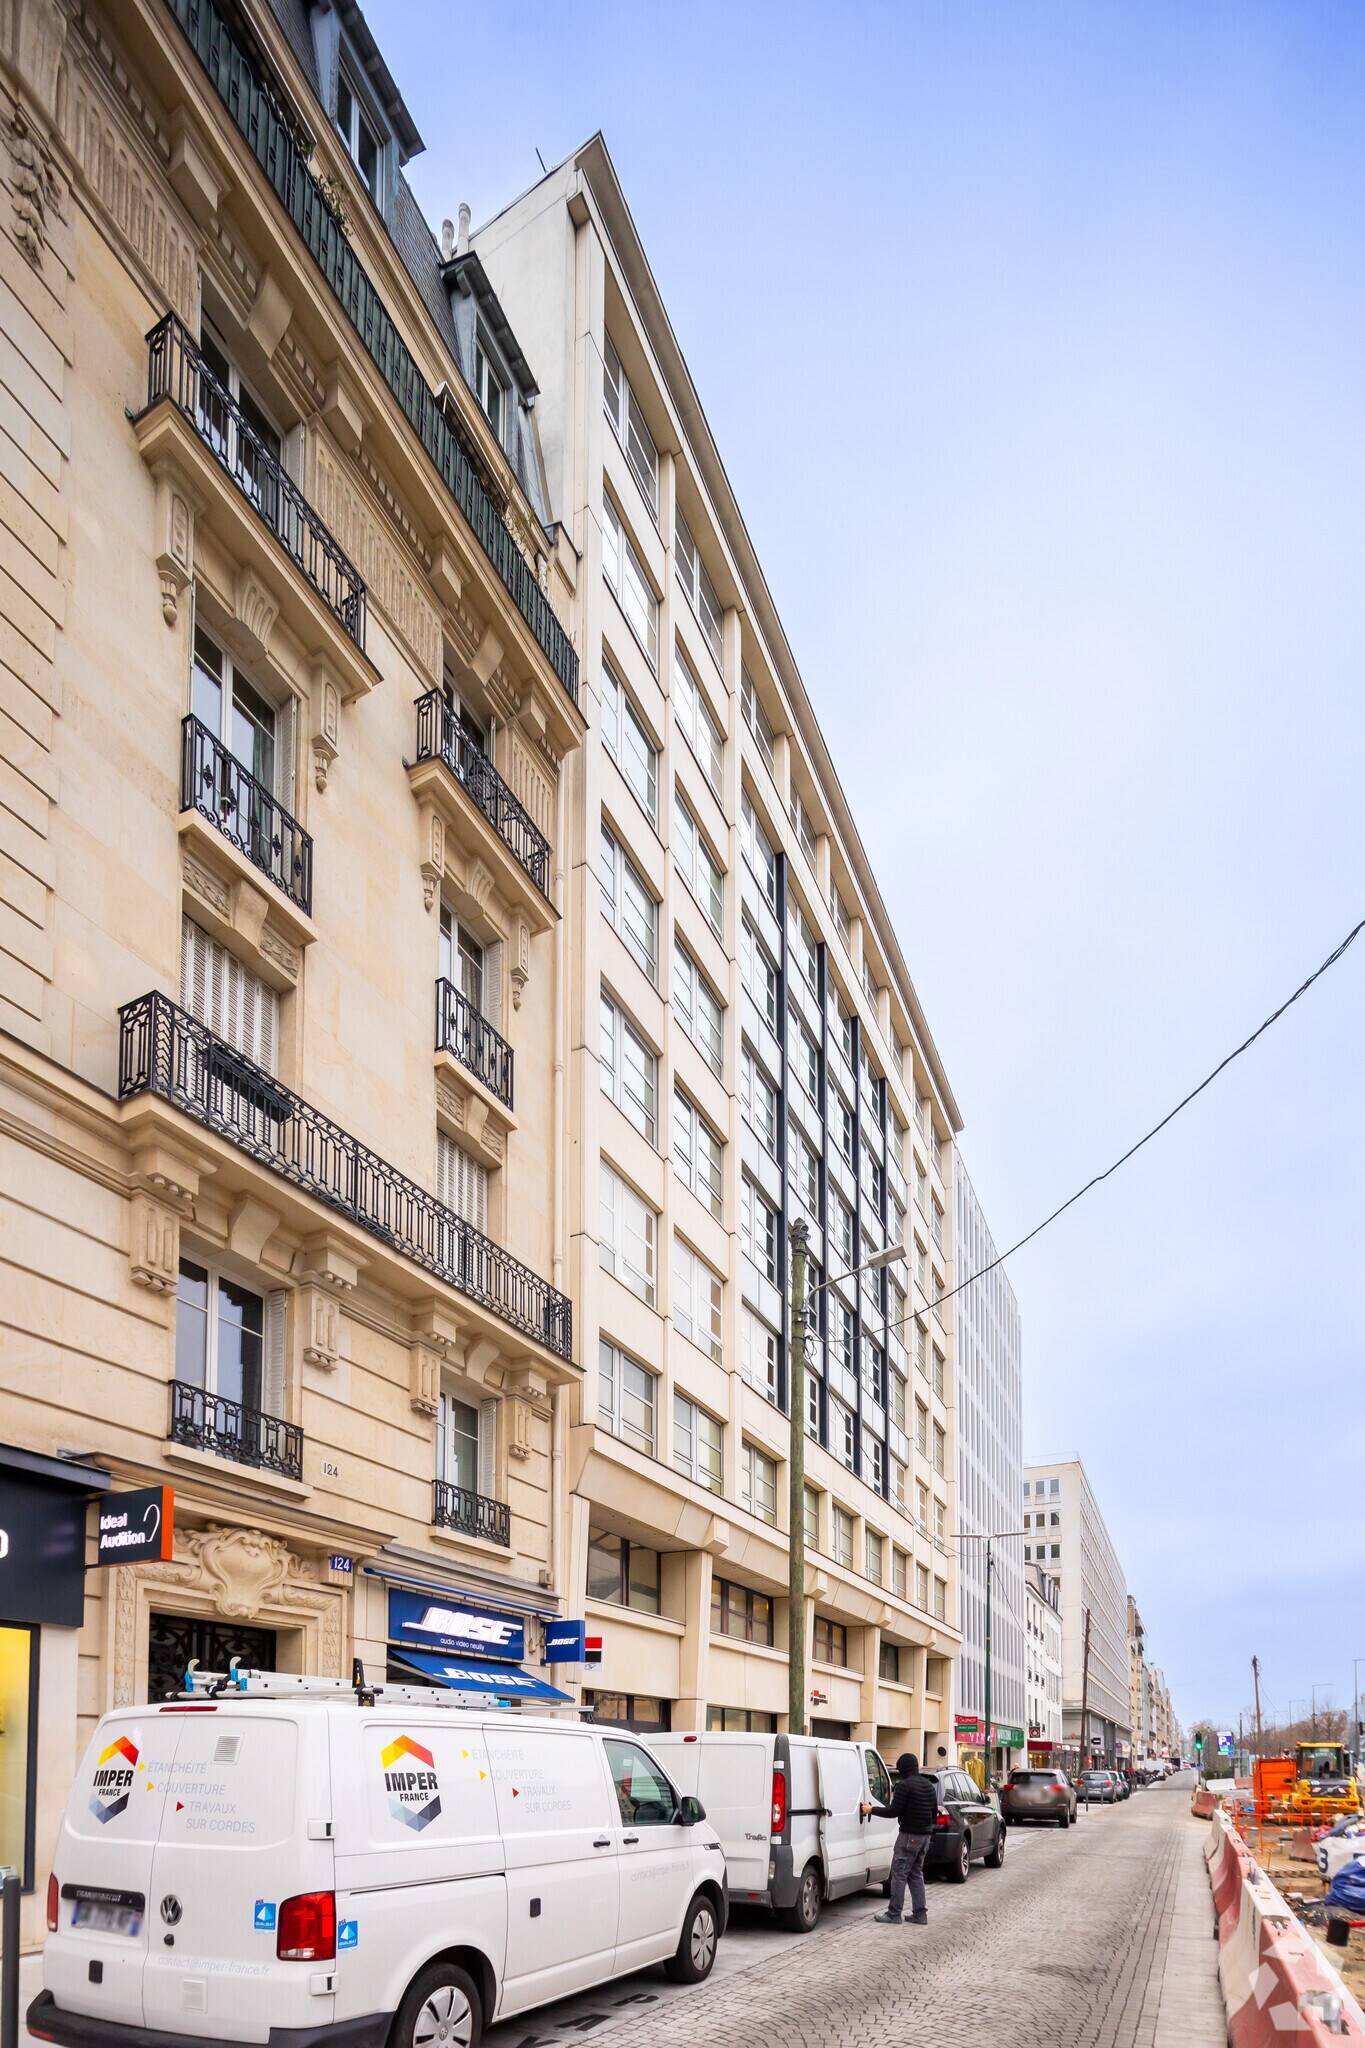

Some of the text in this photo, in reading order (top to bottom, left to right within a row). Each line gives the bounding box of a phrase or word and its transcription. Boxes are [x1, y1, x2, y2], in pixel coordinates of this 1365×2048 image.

[323, 1462, 339, 1478] 124
[100, 1512, 128, 1531] Ideal
[100, 1531, 146, 1549] Audition
[334, 1556, 350, 1571] 124
[401, 1606, 523, 1645] BOSE
[440, 1638, 485, 1651] audio video neuilly
[547, 1637, 579, 1646] BOSE
[433, 1667, 541, 1688] BOSE
[147, 1760, 208, 1774] ÉTANCHÉITÉ
[93, 1770, 134, 1787] IMPER
[384, 1772, 439, 1792] IMPER
[98, 1788, 121, 1797] FRANCE
[157, 1782, 226, 1796] COUVERTURE
[521, 1785, 556, 1797] TRAVAUX
[399, 1792, 429, 1802] FRANCE
[189, 1801, 237, 1814] TRAVAUX
[524, 1800, 572, 1814] SUR CORDES
[186, 1818, 256, 1833] SUR CORDES
